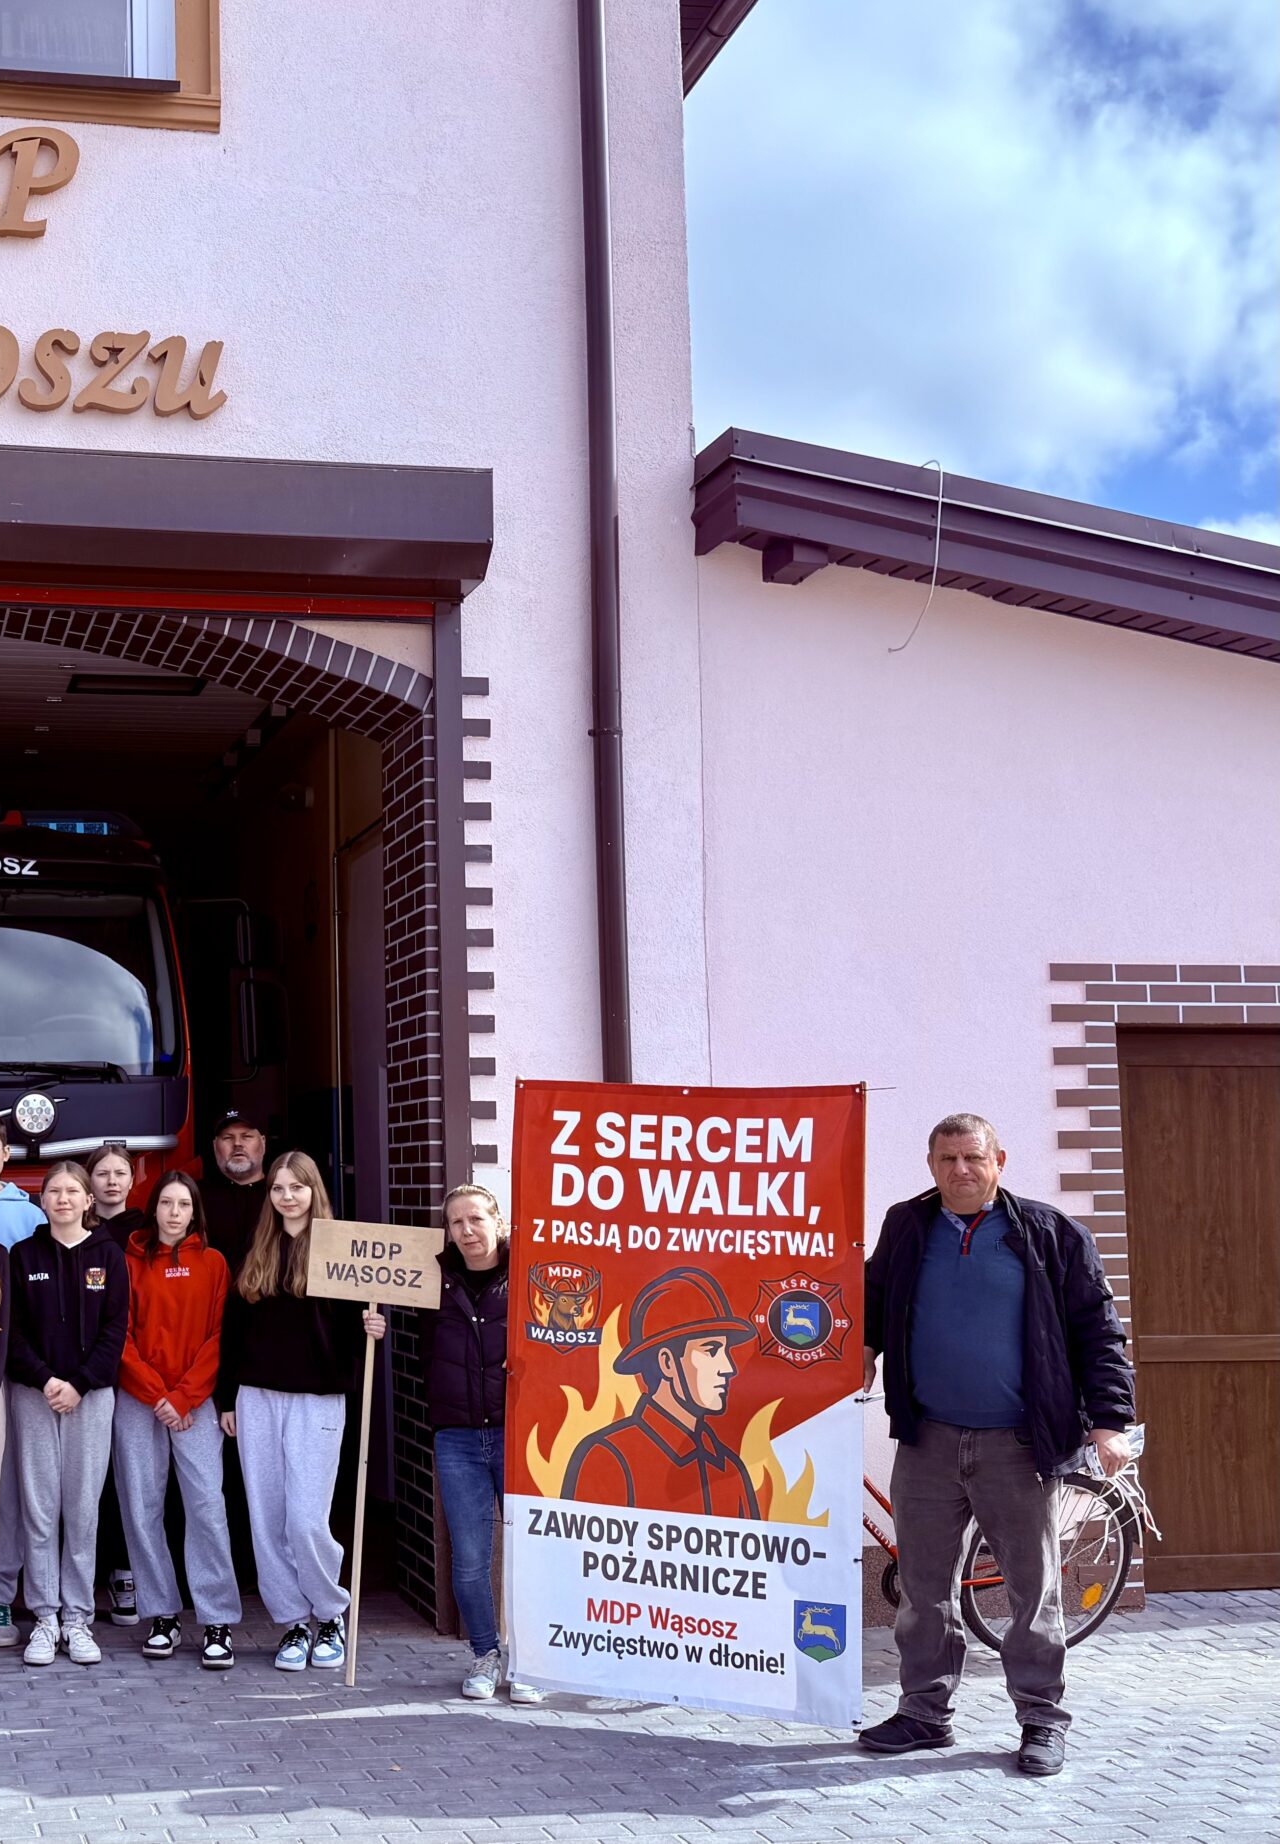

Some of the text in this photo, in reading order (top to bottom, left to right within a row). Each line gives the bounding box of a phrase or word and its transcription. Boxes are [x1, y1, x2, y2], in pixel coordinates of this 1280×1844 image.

[550, 1110, 814, 1163] Z SERCEM
[551, 1162, 821, 1225] DO WALKI,
[350, 1239, 402, 1260] MDP
[532, 1219, 834, 1260] Z PASJĄ DO ZWYCIĘSTWA!
[28, 1272, 49, 1281] MAJA
[325, 1261, 423, 1288] WĄSOSZ
[548, 1266, 582, 1279] MDP
[780, 1279, 820, 1291] KSRG
[754, 1315, 765, 1323] 18
[834, 1319, 848, 1328] 95
[531, 1326, 597, 1344] WĄSOSZ
[528, 1508, 639, 1547] ZAWODY
[647, 1522, 827, 1567] SPORTOWO-
[582, 1550, 767, 1600] POŻARNICZE
[586, 1598, 738, 1640] MDP Wąsosz
[548, 1623, 786, 1675] Zwycięstwo w dłonie!
